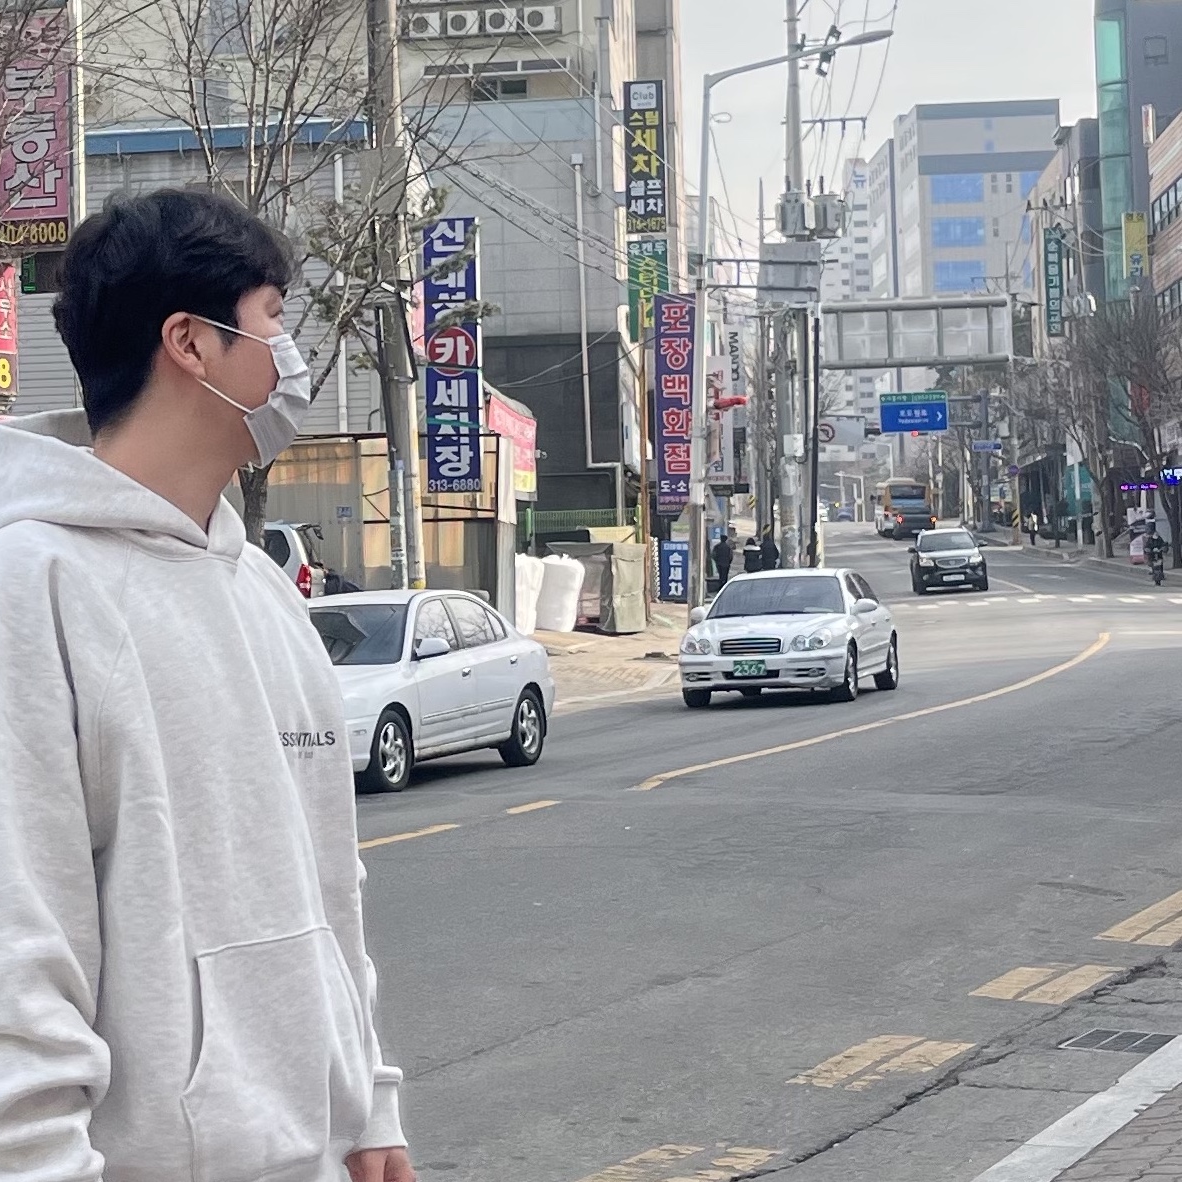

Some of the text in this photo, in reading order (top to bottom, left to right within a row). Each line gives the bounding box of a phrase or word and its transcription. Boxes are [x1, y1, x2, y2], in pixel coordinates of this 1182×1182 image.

[632, 92, 655, 100] Club
[629, 111, 660, 126] 스팀
[631, 129, 660, 177] 세차
[629, 179, 662, 196] 셀프
[629, 198, 663, 215] 세차
[629, 241, 665, 255] 유캔두
[661, 302, 692, 475] 포장백화점
[429, 478, 480, 492] 313-6880
[661, 480, 689, 493] 도·소
[733, 664, 766, 677] 2367
